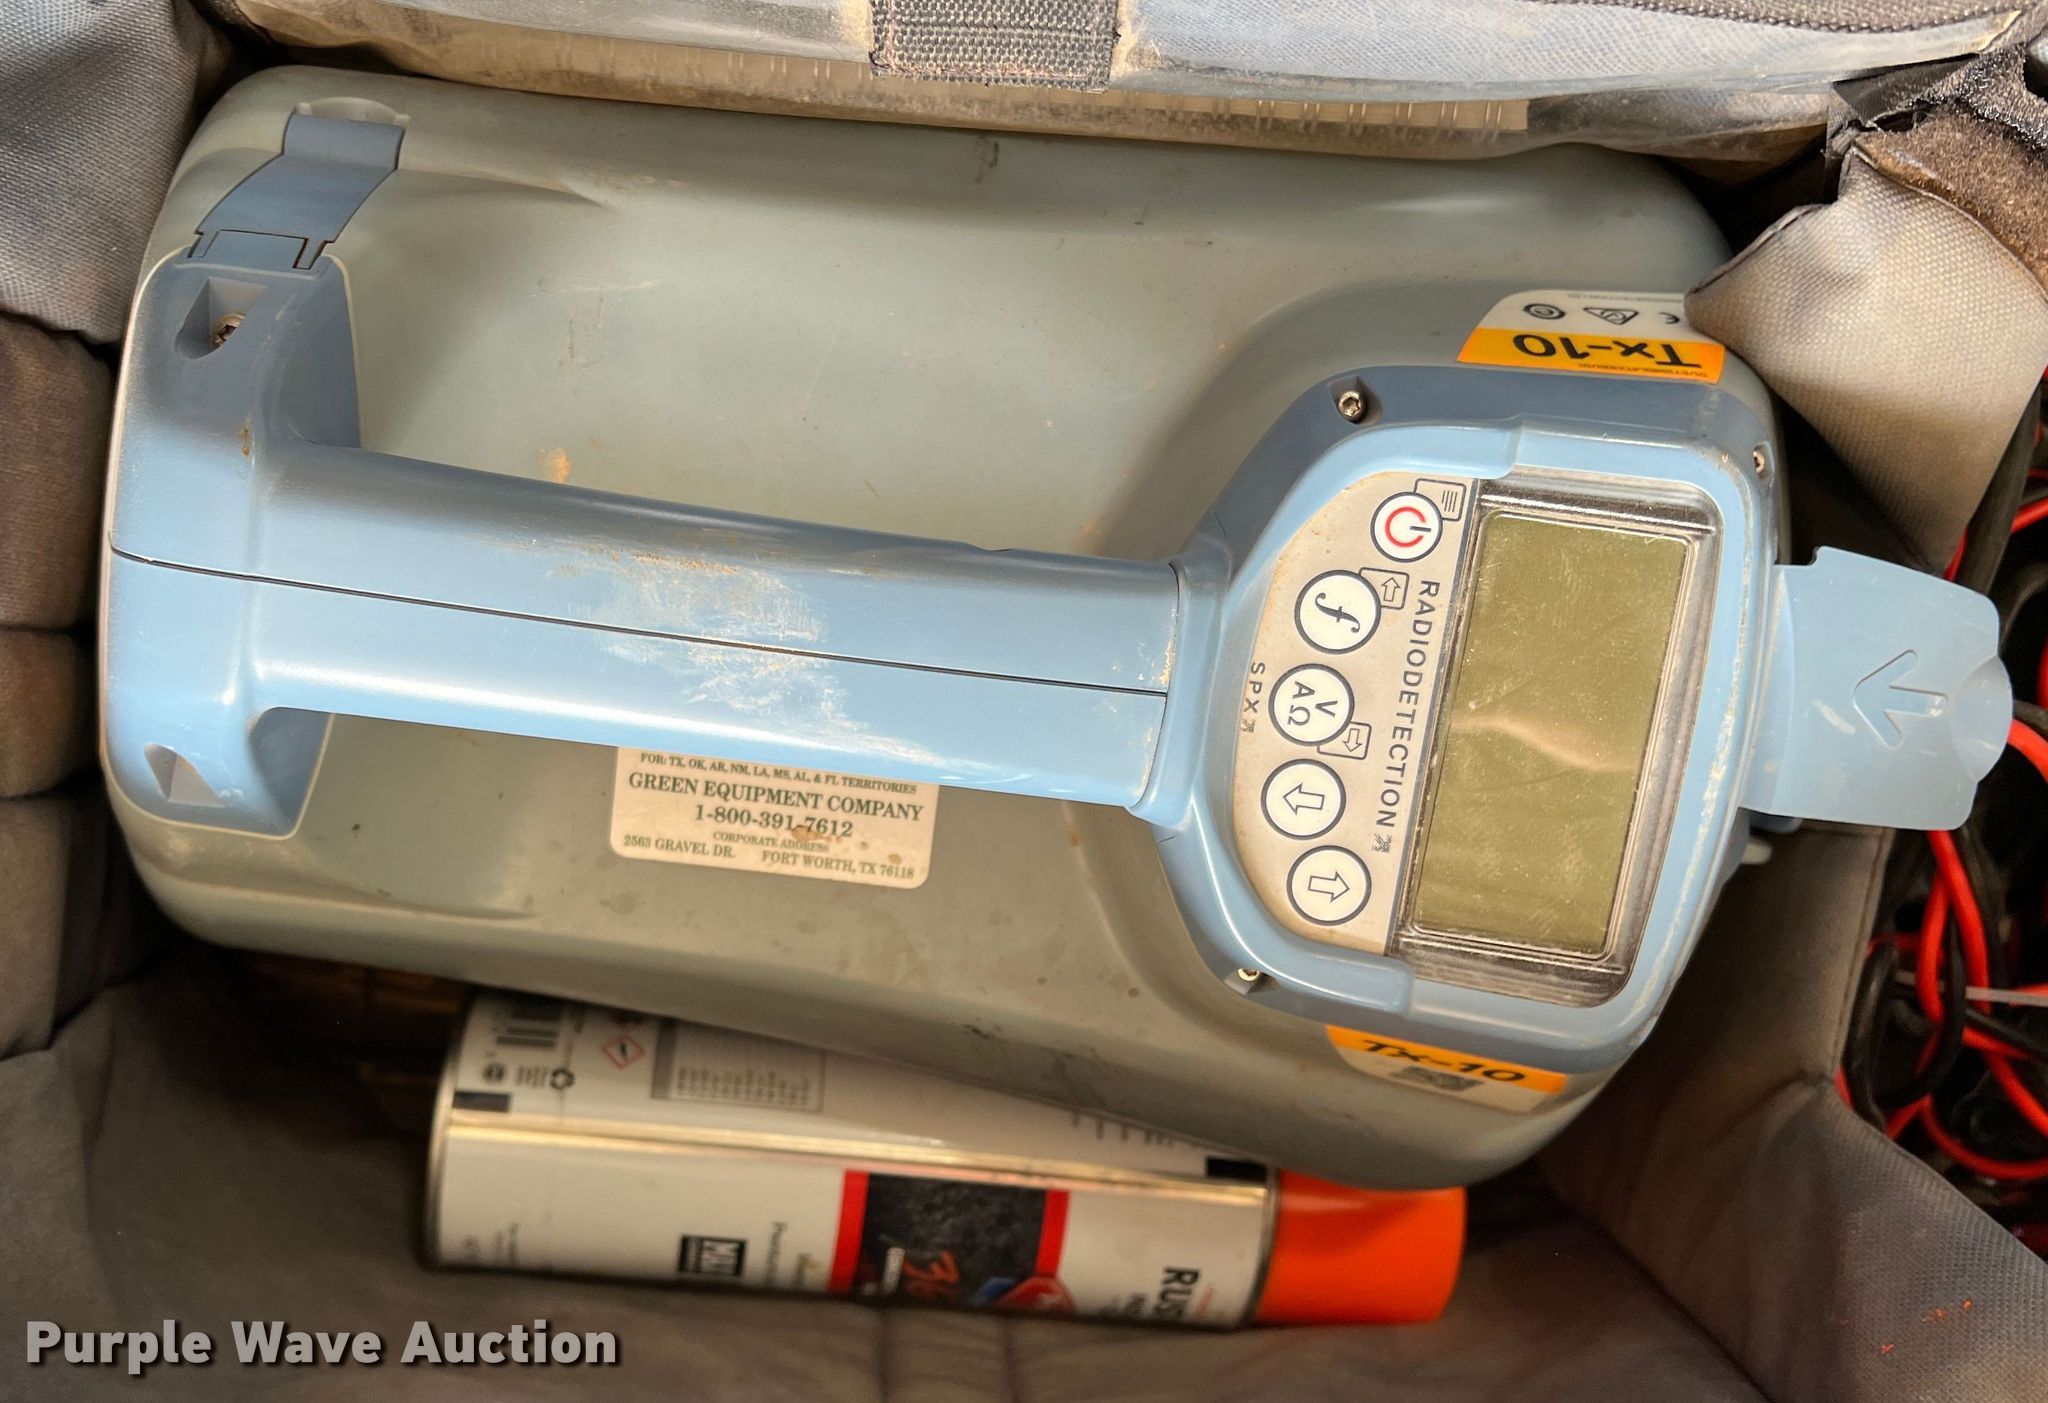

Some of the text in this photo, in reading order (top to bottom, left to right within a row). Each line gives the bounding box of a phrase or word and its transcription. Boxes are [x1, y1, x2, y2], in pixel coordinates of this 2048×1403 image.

[1243, 662, 1266, 713] SPX
[1376, 578, 1441, 828] RADIODETECTION
[640, 752, 666, 765] FOR:
[669, 756, 686, 768] TX,
[688, 759, 707, 771] OK,
[709, 763, 728, 773] AR,
[730, 764, 751, 776] NM,
[753, 767, 771, 778] LA,
[773, 768, 791, 781] MS,
[793, 771, 811, 783] AL,
[813, 773, 822, 784] &
[841, 776, 917, 794] TERRITORIES
[629, 771, 924, 821] GREEN EQUIPMENT COMPANY
[695, 804, 854, 838] 1-800-391-7612
[713, 831, 830, 853] CORPORATE ADDRESS
[655, 838, 709, 855] GRAVEL
[762, 850, 799, 865] FORT
[803, 855, 856, 874] WORTH,
[859, 862, 876, 874] TX
[880, 864, 914, 879] 76118
